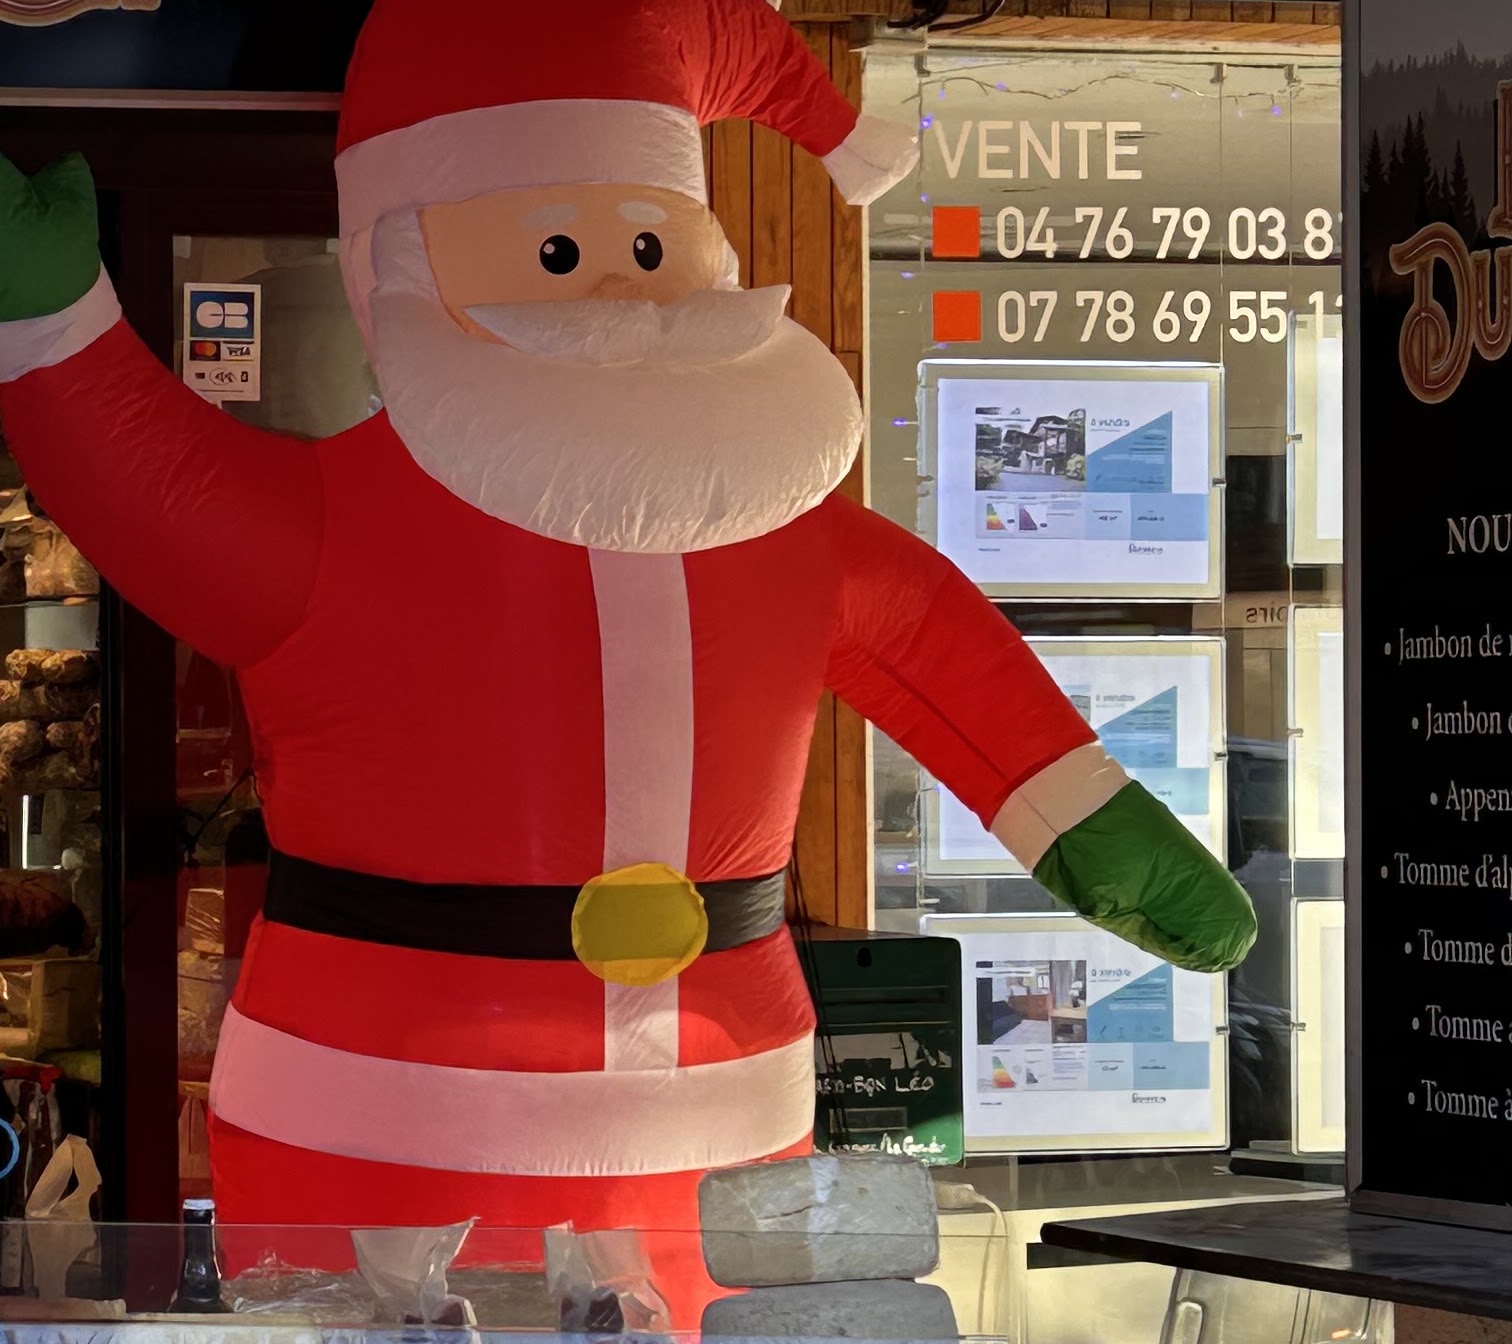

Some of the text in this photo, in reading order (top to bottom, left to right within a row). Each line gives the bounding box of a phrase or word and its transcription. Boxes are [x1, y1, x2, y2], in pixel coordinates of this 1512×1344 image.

[933, 120, 1142, 180] VENTE
[996, 206, 1343, 260] 04 76 79 03 8
[196, 301, 248, 328] CB
[997, 290, 1343, 343] 07 78 69 55 1
[1399, 624, 1472, 665] Jambon
[1479, 623, 1502, 656] de
[1426, 700, 1502, 740] Jambon
[1445, 780, 1512, 822] Appen
[1394, 852, 1469, 887] Tomme
[1418, 929, 1494, 965] Tomme
[1425, 1005, 1502, 1042] Tomme
[1421, 1080, 1497, 1119] Tomme
